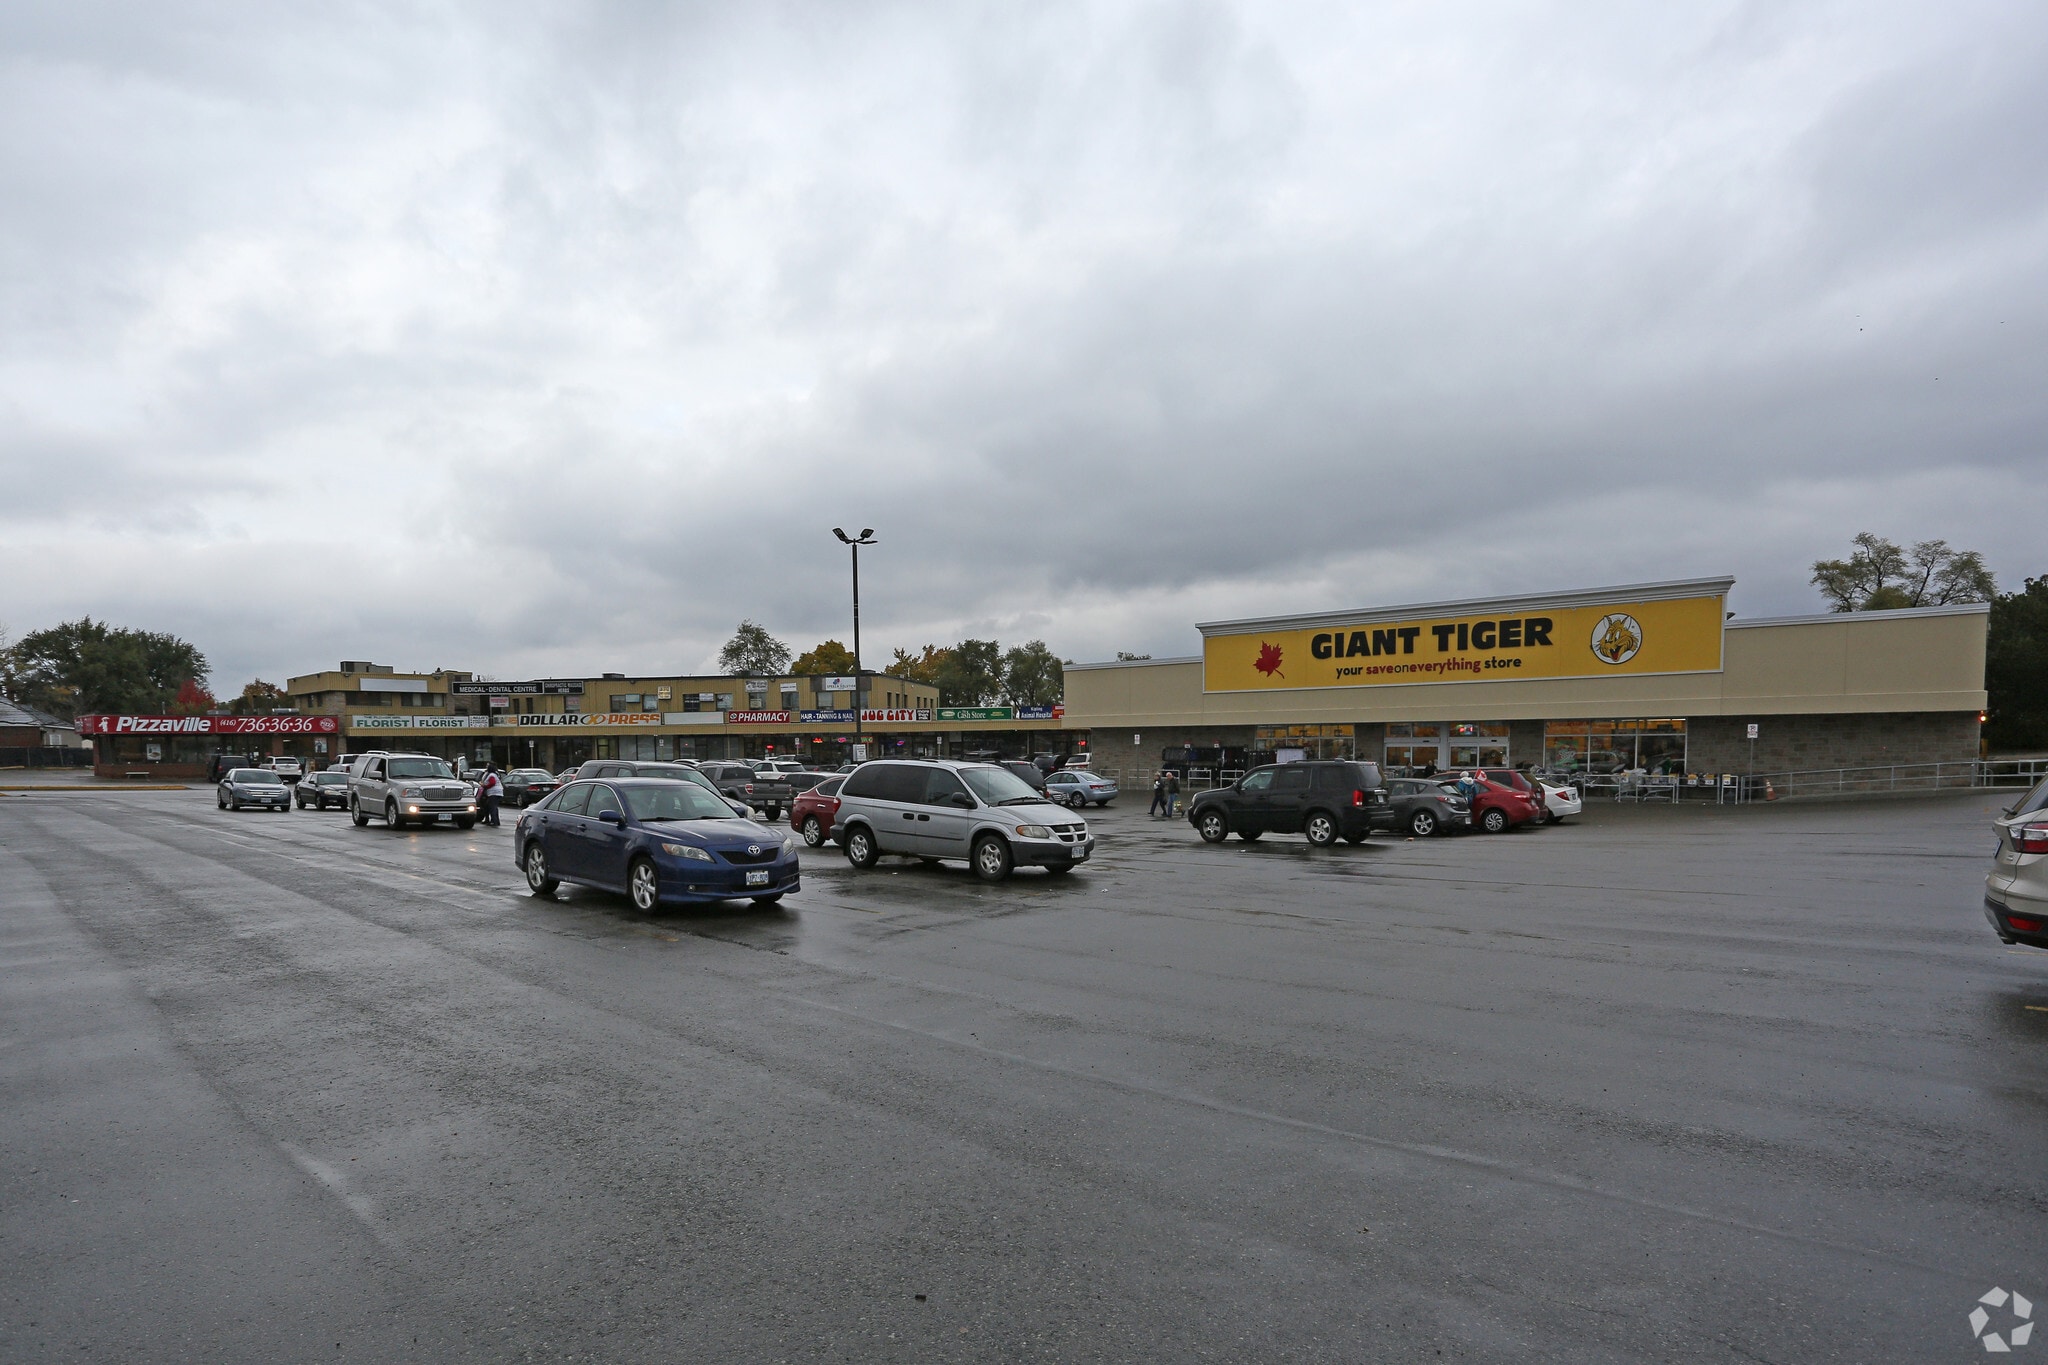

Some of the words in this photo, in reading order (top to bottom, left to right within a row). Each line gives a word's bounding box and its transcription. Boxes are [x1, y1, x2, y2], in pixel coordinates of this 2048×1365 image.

[1311, 627, 1421, 660] GIANT
[1432, 617, 1553, 652] TIGER
[1336, 664, 1363, 679] your
[1484, 656, 1522, 670] store
[520, 714, 578, 725] DOLLAR
[737, 712, 789, 722] PHARMACY
[861, 710, 884, 721] JUG
[886, 709, 914, 721] CITY
[957, 711, 971, 719] Cash
[971, 711, 987, 719] Store
[1036, 711, 1053, 719] Hospital
[116, 716, 211, 732] Pizzaville
[357, 719, 409, 728] FLORIST
[419, 719, 464, 728] FLORIST
